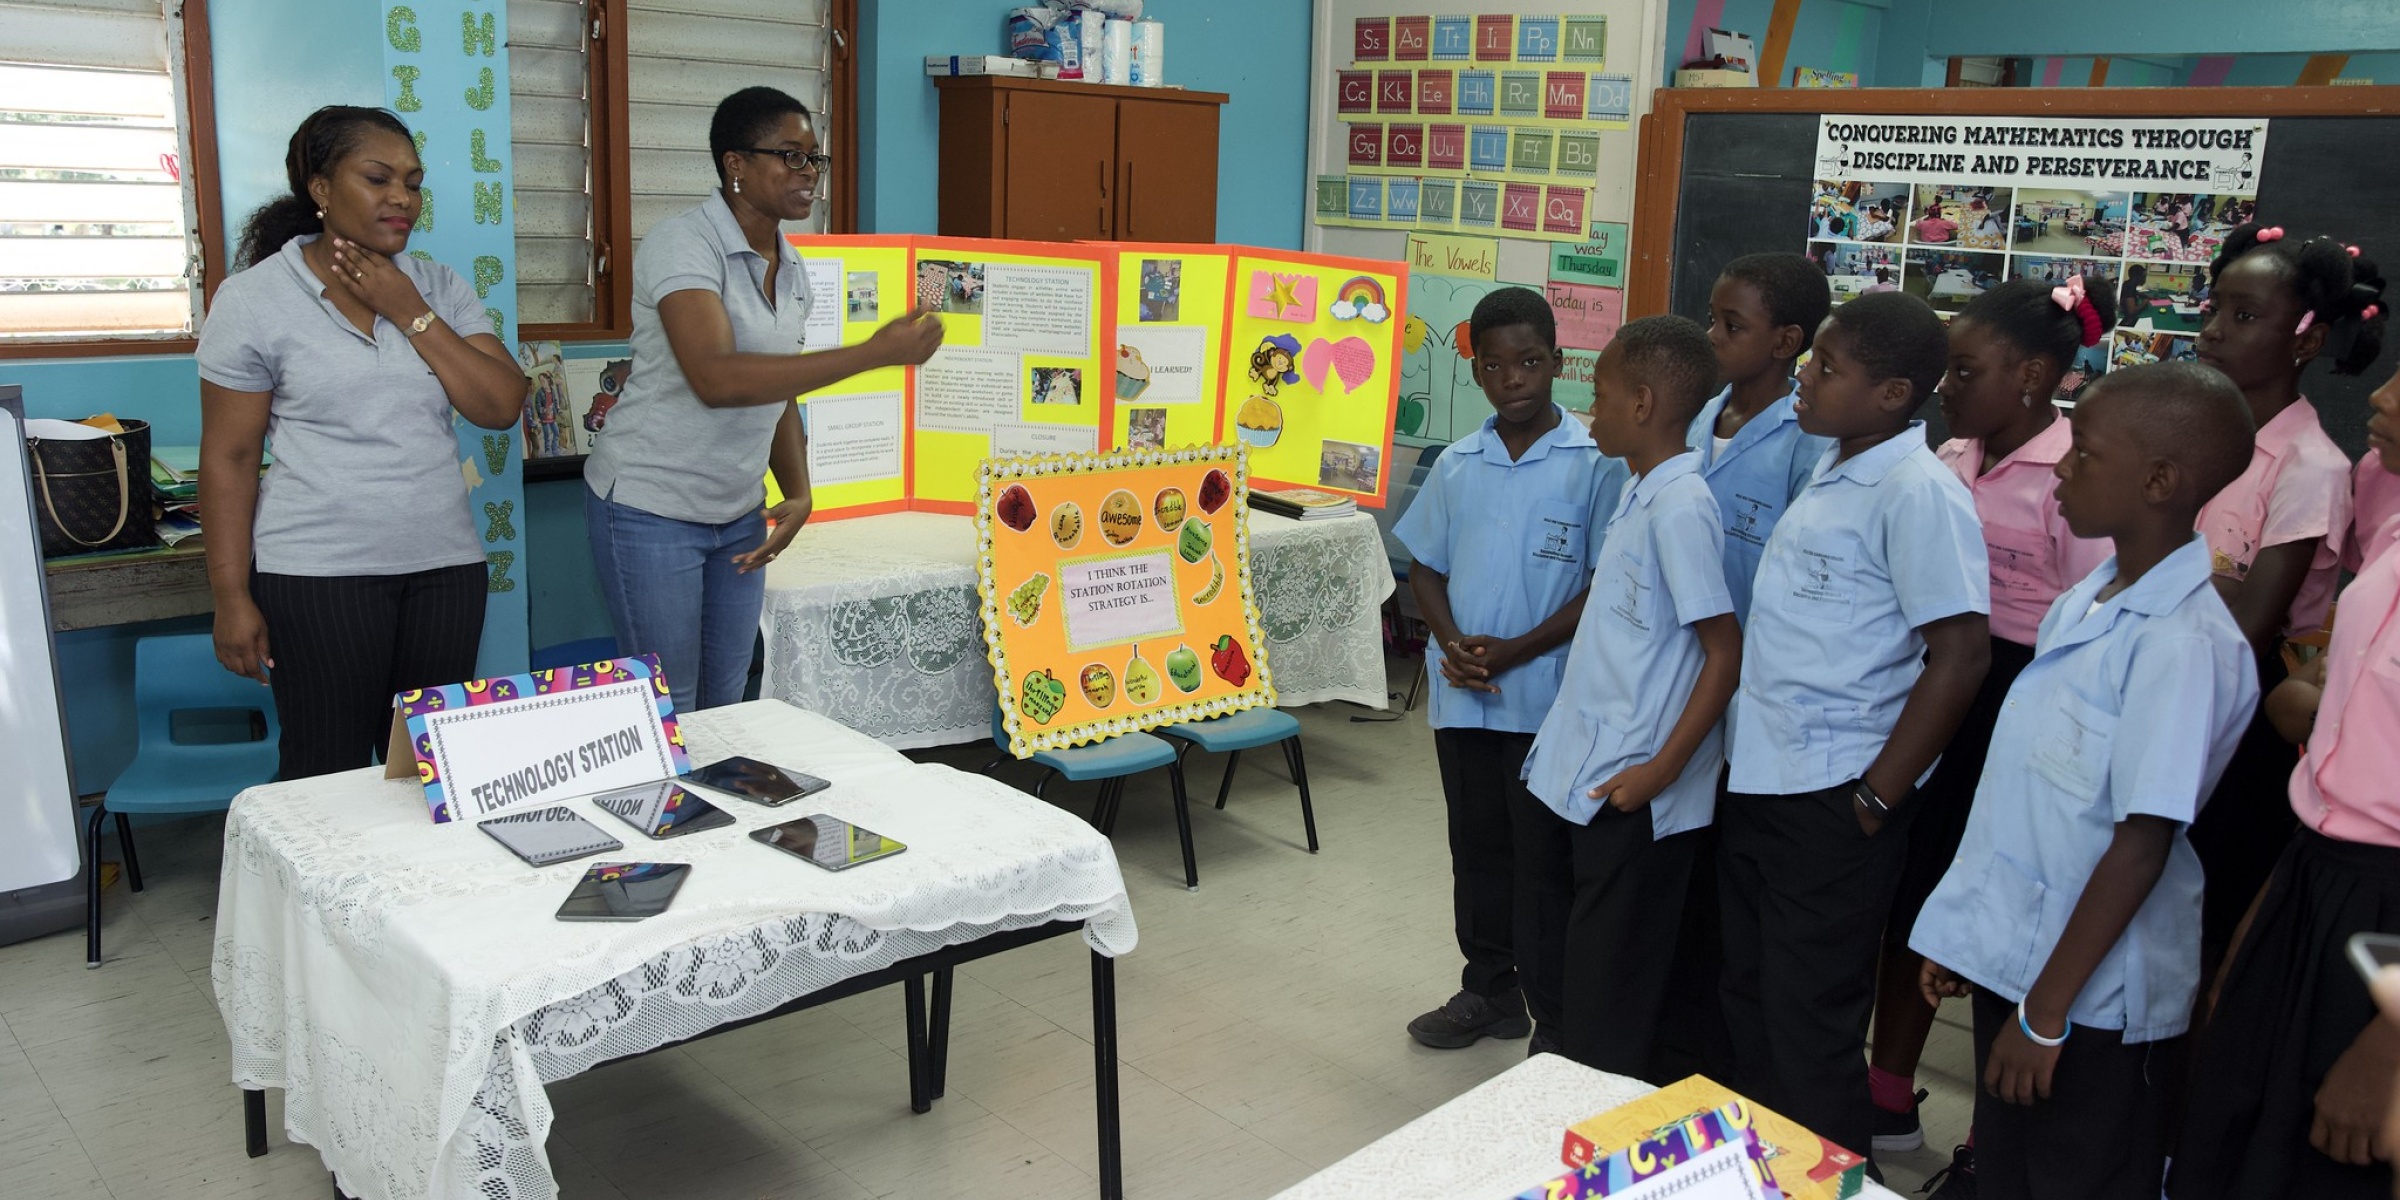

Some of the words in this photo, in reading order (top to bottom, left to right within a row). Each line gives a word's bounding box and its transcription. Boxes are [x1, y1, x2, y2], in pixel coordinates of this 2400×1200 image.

[387, 5, 421, 53] G
[462, 10, 495, 57] H
[1363, 30, 1379, 50] Ss
[1400, 29, 1422, 49] Aa
[1442, 27, 1459, 46] Tt
[1486, 28, 1497, 48] Ii
[1527, 28, 1549, 53] Pp
[1573, 27, 1594, 50] Nn
[392, 64, 422, 112] I
[464, 66, 494, 111] J
[1811, 69, 1844, 81] Spelling
[1345, 83, 1366, 102] Cc
[1384, 83, 1404, 102] Kk
[1423, 83, 1442, 103] Ee
[1464, 83, 1487, 103] Hh
[1509, 83, 1530, 104] Rr
[1549, 84, 1577, 106] Mm
[1598, 85, 1623, 107] Dd
[471, 128, 501, 173] L
[1354, 135, 1376, 159] Gg
[1393, 135, 1415, 155] Oo
[1433, 136, 1454, 156] Uu
[1480, 137, 1495, 159] Ll
[1523, 139, 1542, 161] Ff
[1566, 143, 1592, 165] Bb
[1827, 124, 1957, 145] CONQUERING
[1964, 127, 2124, 149] MATHEMATICS
[2132, 129, 2253, 150] THROUGH
[1853, 151, 1964, 173] DISCIPLINE
[1971, 156, 2018, 176] AND
[2026, 156, 2210, 181] PERSEVERANCE
[474, 181, 503, 225] N
[1355, 188, 1375, 208] Zz
[1390, 189, 1417, 209] Ww
[1429, 191, 1445, 211] Vv
[1469, 192, 1485, 216] Yy
[1508, 195, 1528, 219] Xx
[1548, 198, 1576, 226] Qq
[1411, 239, 1434, 268] The
[1446, 246, 1492, 275] Vowels
[1561, 256, 1611, 276] Thursday
[1574, 245, 1603, 256] was
[474, 255, 504, 299] P
[1548, 287, 1586, 319] Today
[1592, 298, 1603, 312] is
[482, 433, 510, 476] V
[484, 499, 516, 543] X
[1070, 584, 1114, 599] STATION
[1117, 576, 1167, 592] ROTATION
[1089, 571, 1091, 581] I
[1096, 568, 1126, 580] THINK
[1130, 564, 1148, 574] THE
[1088, 595, 1137, 612] STRATEGY
[470, 749, 578, 816] TECHNOLOGY
[579, 724, 644, 774] STATION
